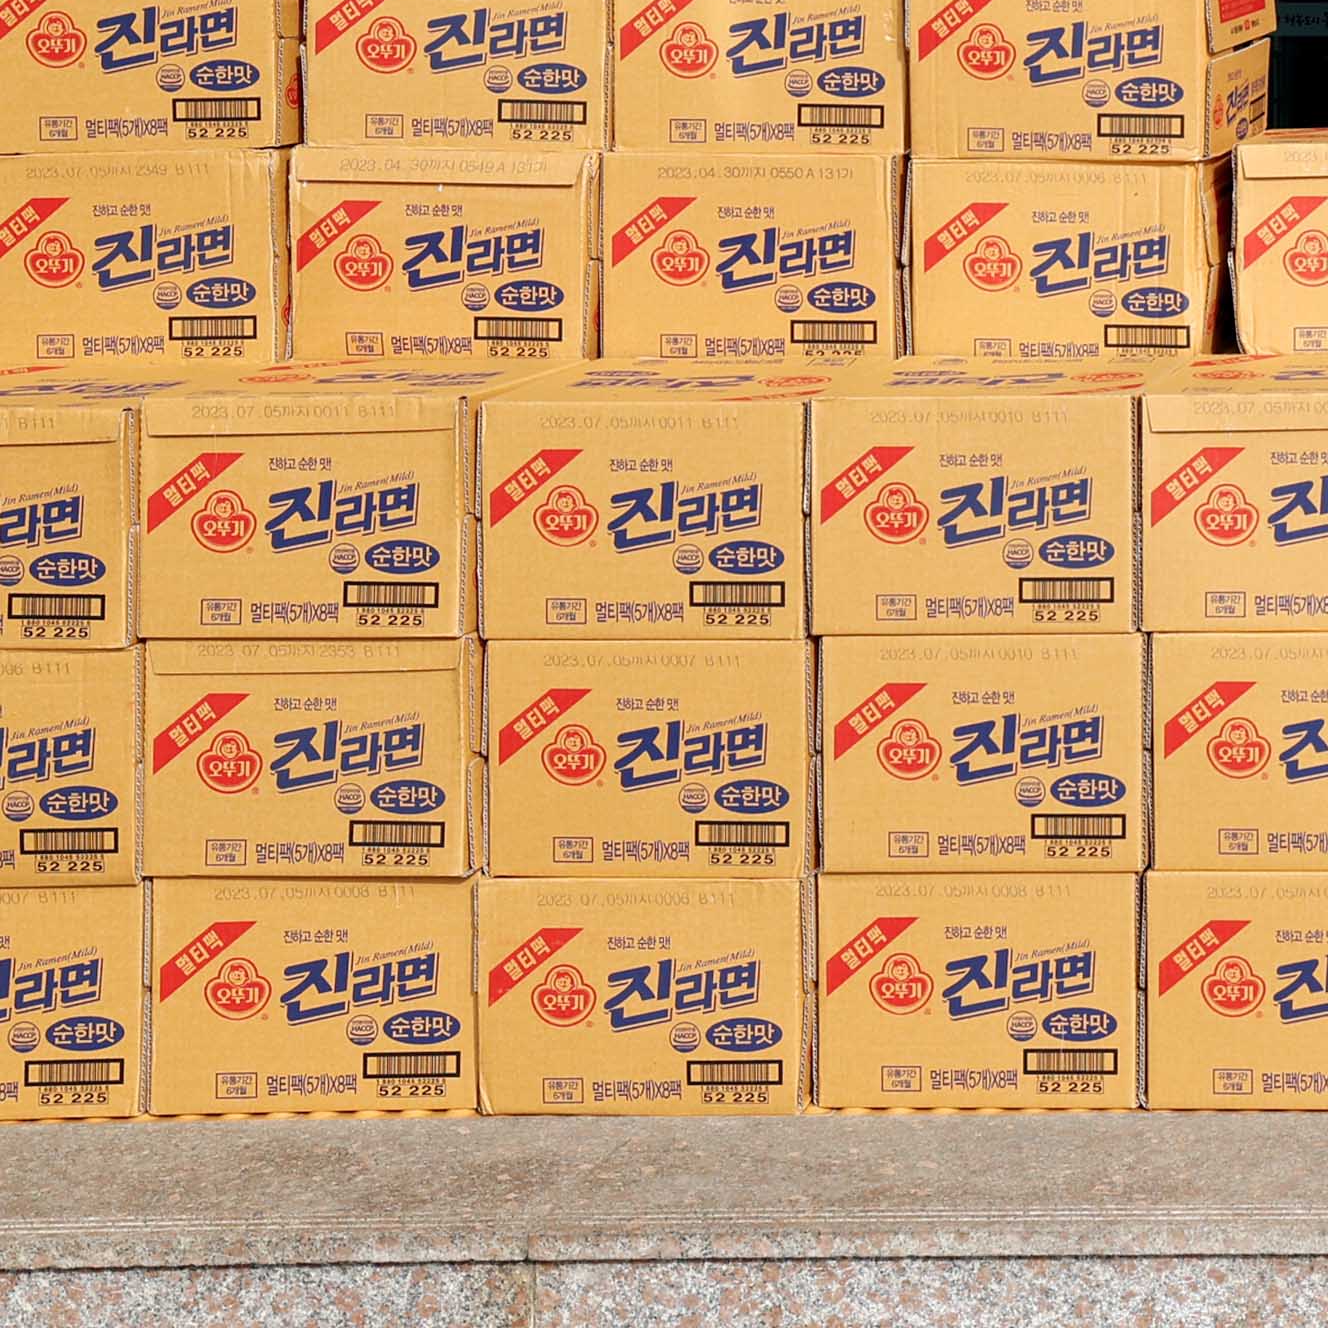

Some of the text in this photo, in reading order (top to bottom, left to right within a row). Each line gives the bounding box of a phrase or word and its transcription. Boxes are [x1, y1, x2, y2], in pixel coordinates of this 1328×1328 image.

[94, 4, 239, 74] 진라면
[424, 6, 570, 76] 진라면
[726, 8, 870, 81] 진라면
[1024, 19, 1164, 90] 진라면
[92, 222, 236, 292] 진라면
[402, 225, 545, 293] 진라면
[717, 225, 856, 295] 진라면
[1030, 231, 1170, 300] 진라면
[264, 478, 421, 555] 진라면
[608, 480, 763, 555] 진라면
[938, 474, 1093, 550] 진라면
[270, 718, 427, 796] 진라면
[614, 719, 768, 794] 진라면
[950, 713, 1104, 787] 진라면
[280, 950, 439, 1026] 진라면
[605, 958, 761, 1032] 진라면
[942, 948, 1096, 1021] 진라면
